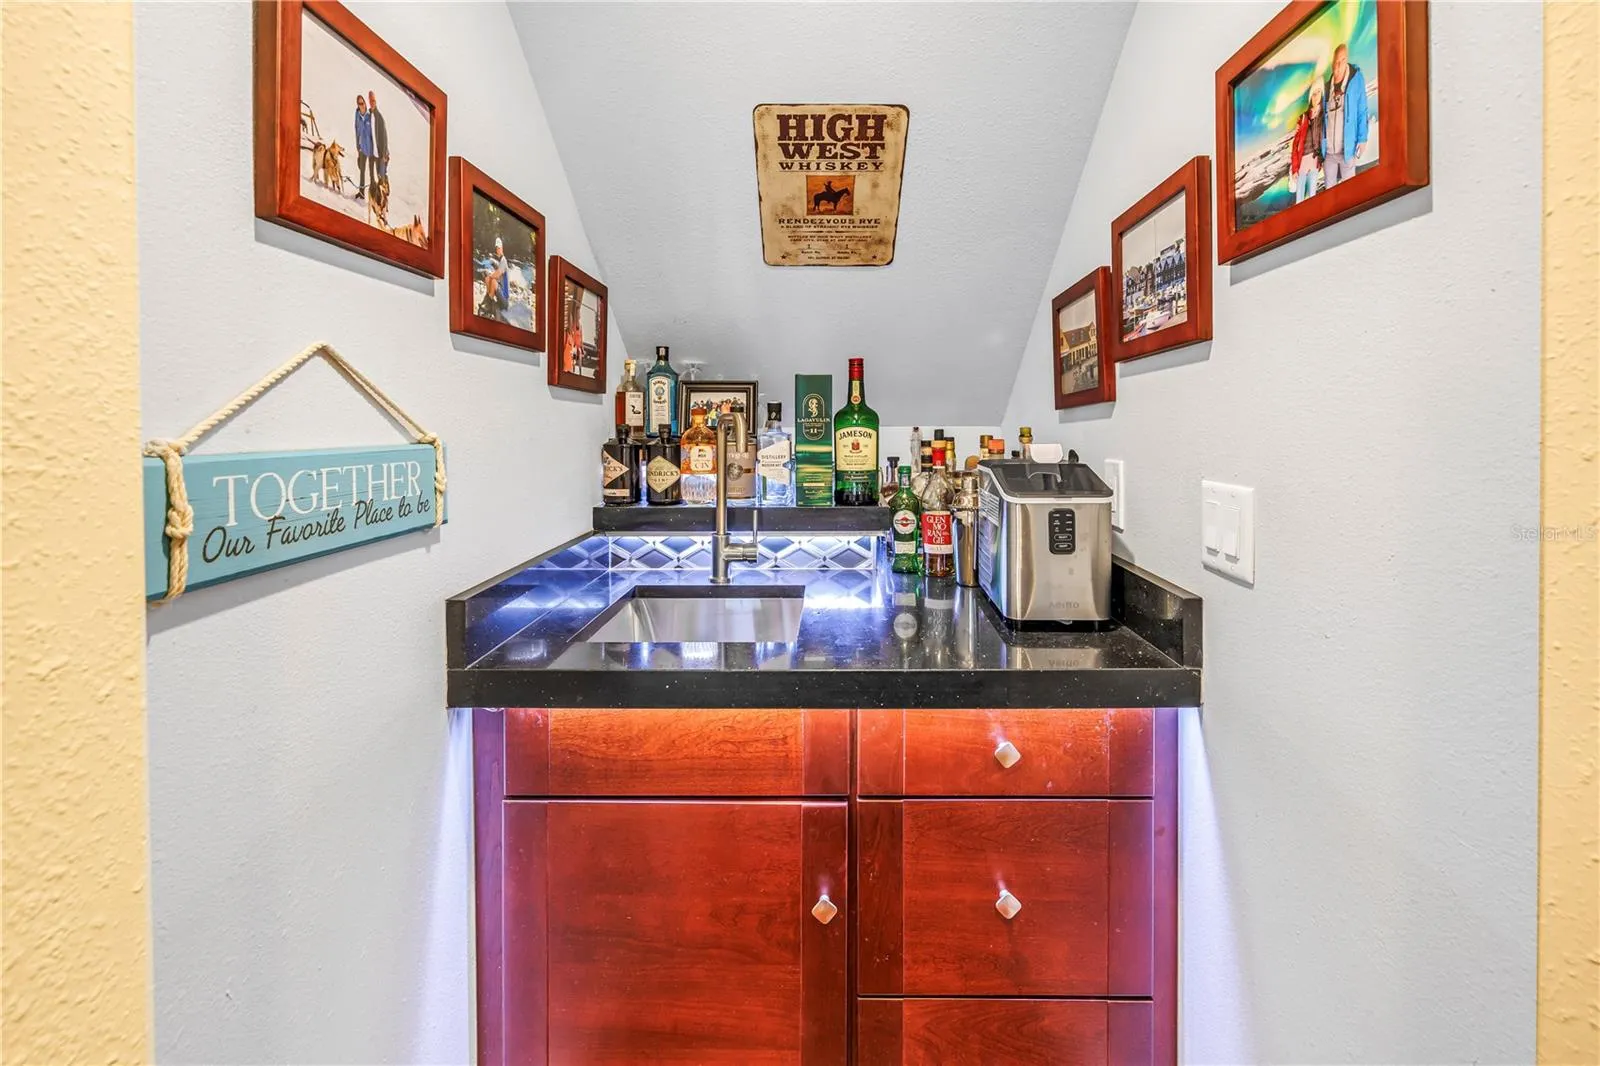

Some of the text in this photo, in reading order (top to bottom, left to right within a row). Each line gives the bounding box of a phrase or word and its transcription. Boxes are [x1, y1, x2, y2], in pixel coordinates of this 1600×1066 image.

[776, 113, 887, 142] HIGH
[778, 143, 885, 160] WEST
[778, 161, 884, 171] WHISKEY
[839, 430, 873, 440] JAMESON
[212, 460, 421, 527] TOGETHER
[926, 515, 946, 523] GLEN
[202, 489, 431, 563] Our Favorite Place to be
[927, 529, 942, 537] RAN
[932, 536, 945, 544] GIE
